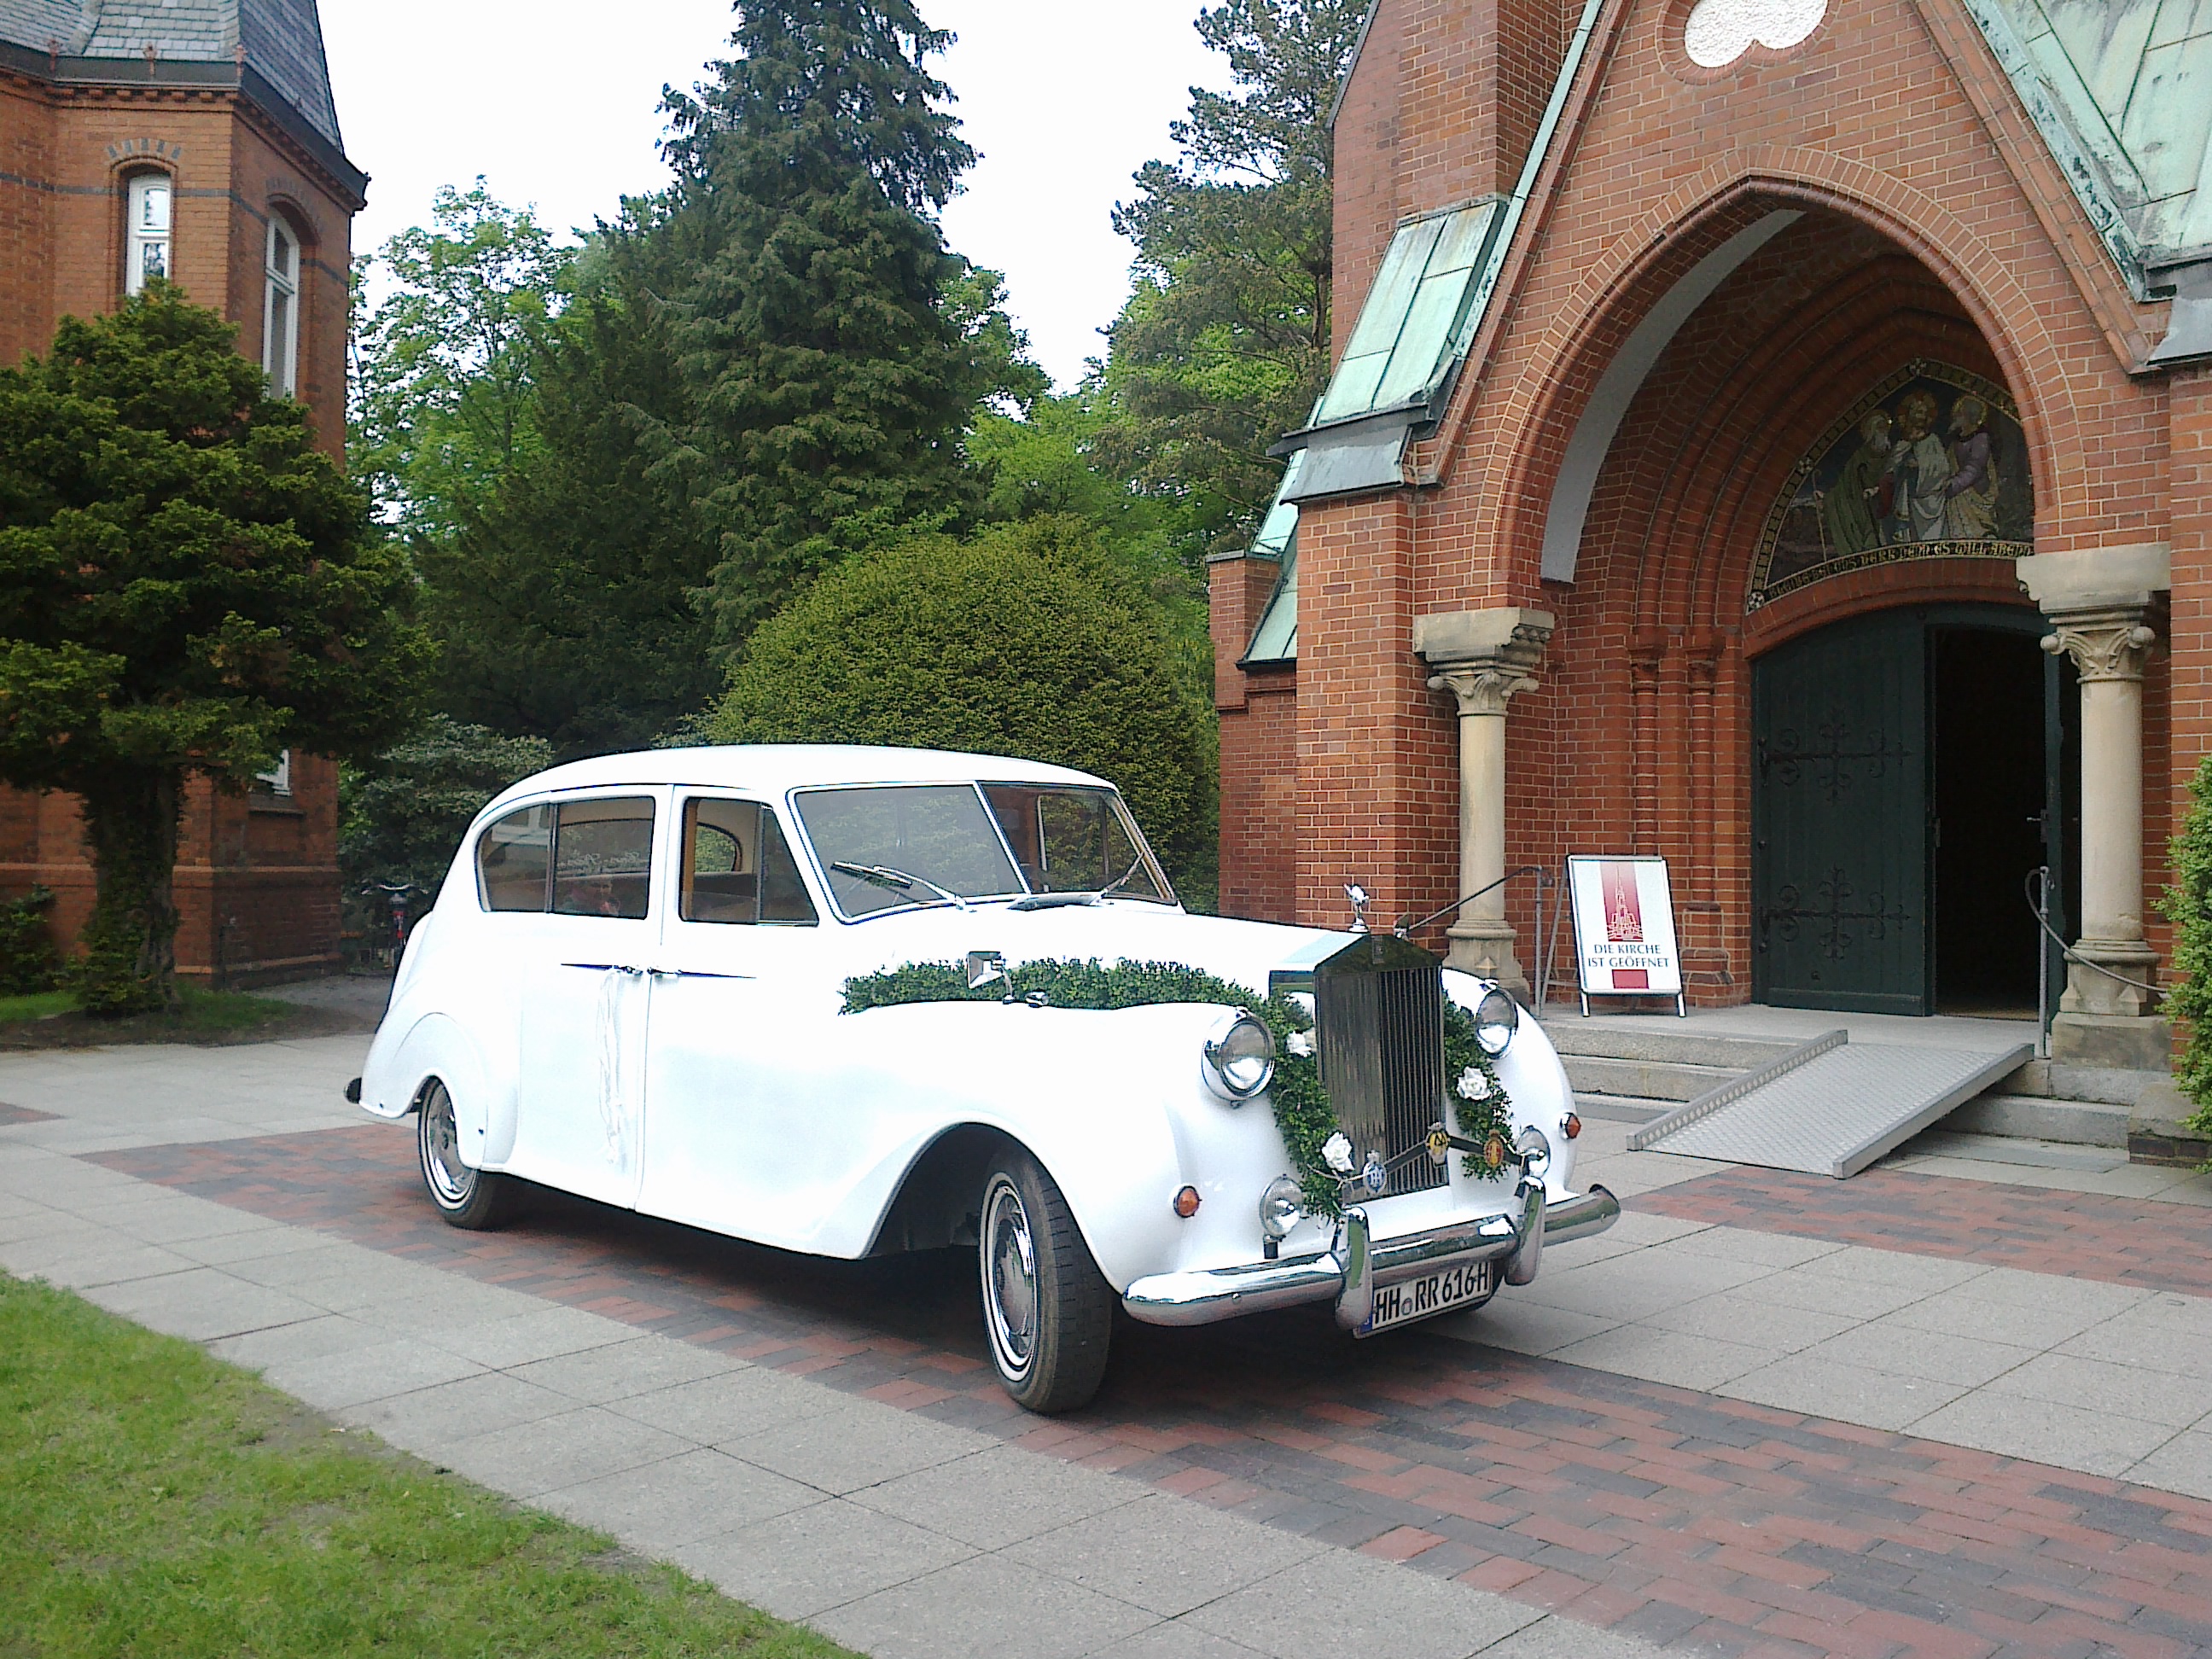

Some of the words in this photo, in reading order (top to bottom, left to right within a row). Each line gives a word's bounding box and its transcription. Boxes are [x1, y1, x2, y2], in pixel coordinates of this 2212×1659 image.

[1594, 944, 1614, 954] DIE
[1618, 944, 1662, 954] KIRCHE
[1588, 957, 1604, 967] IST
[1609, 955, 1669, 968] GEÖFFNET
[1375, 1287, 1400, 1324] HH
[1415, 1276, 1439, 1313] RR
[1442, 1261, 1488, 1303] 616H
